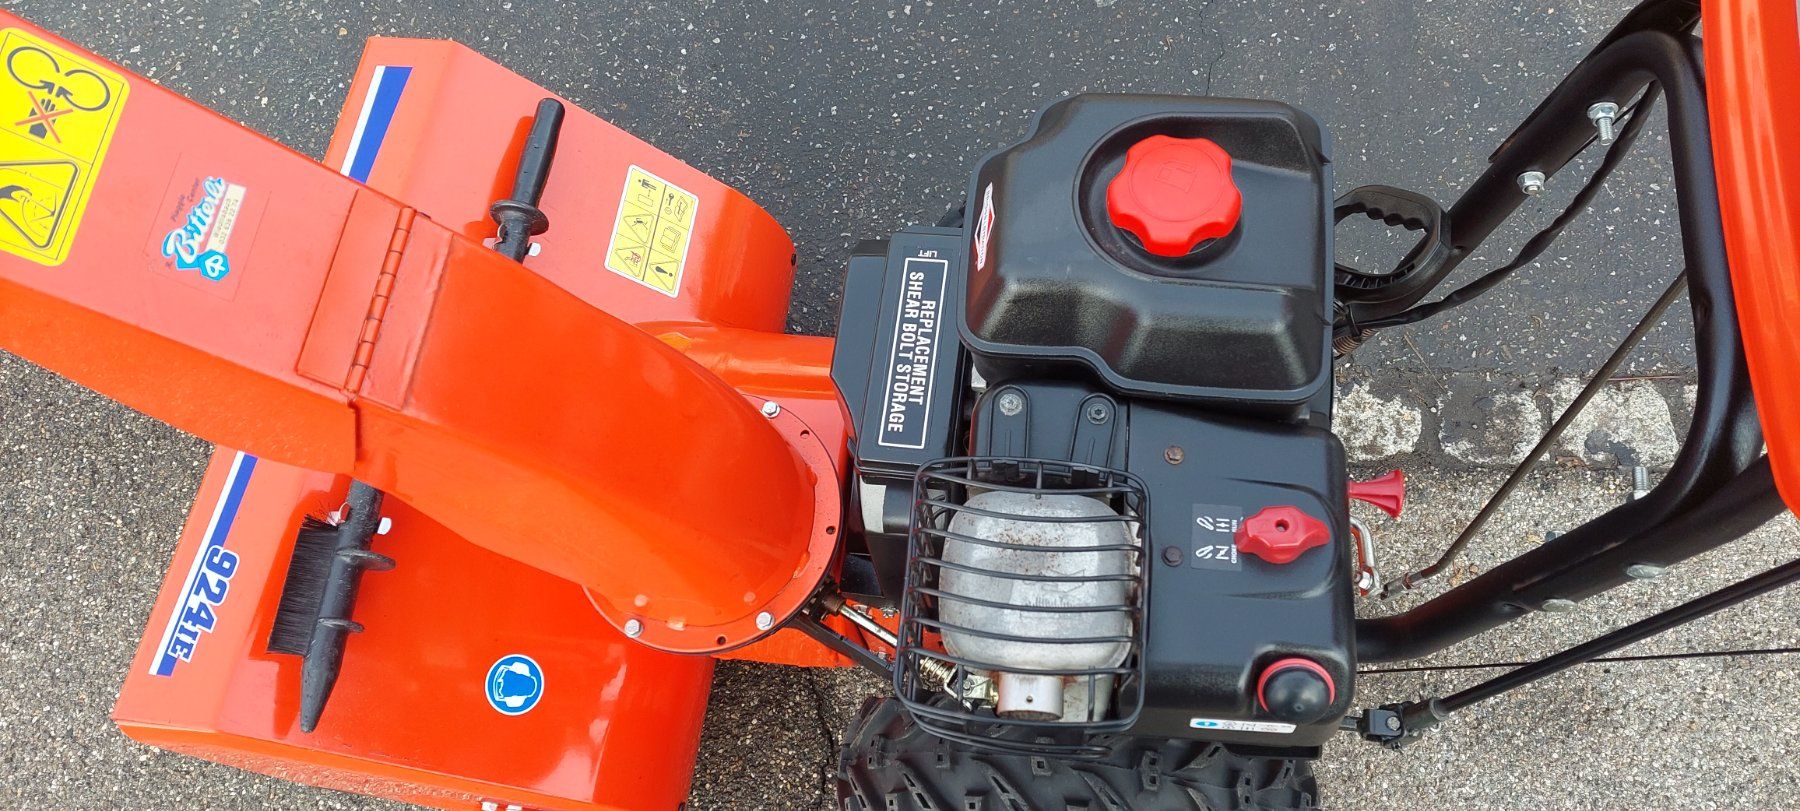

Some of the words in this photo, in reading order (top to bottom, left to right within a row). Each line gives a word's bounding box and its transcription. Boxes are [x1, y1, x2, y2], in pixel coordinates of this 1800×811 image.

[162, 176, 226, 264] Bitterli
[917, 250, 938, 258] LIFT
[904, 271, 925, 318] SHEAR
[899, 324, 917, 360] BOLT
[908, 300, 936, 405] REPLACEMENT
[887, 363, 912, 432] STORAGE
